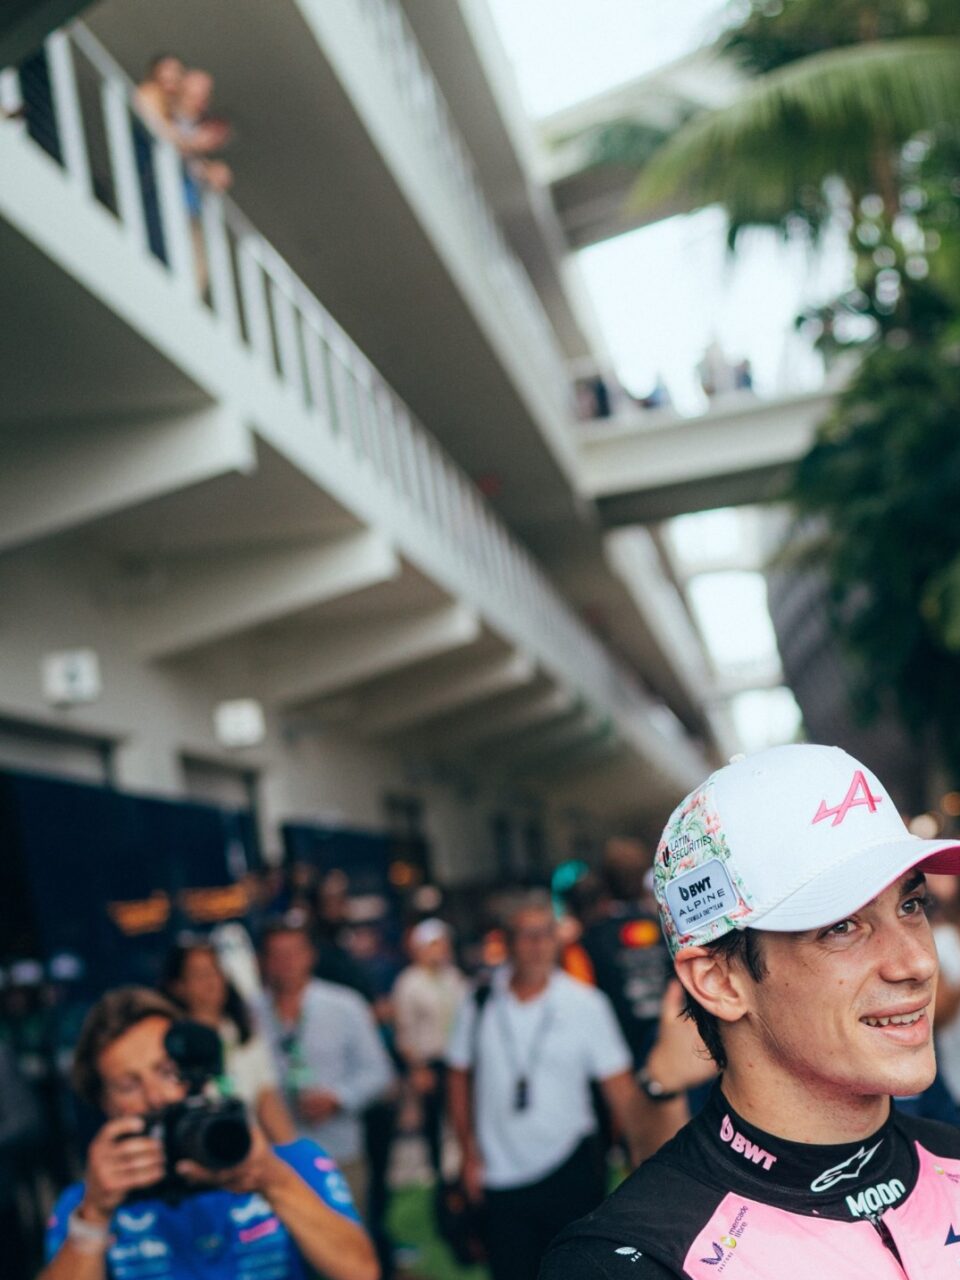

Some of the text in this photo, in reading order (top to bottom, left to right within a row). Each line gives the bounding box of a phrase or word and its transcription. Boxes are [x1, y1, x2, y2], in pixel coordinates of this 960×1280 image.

[670, 833, 690, 852] LATIN
[671, 835, 712, 863] SECURITIES
[688, 876, 712, 898] BWT
[679, 888, 726, 917] ALPINE
[730, 1131, 777, 1171] BWT
[728, 1205, 748, 1236] mercado
[734, 1221, 747, 1238] libre
